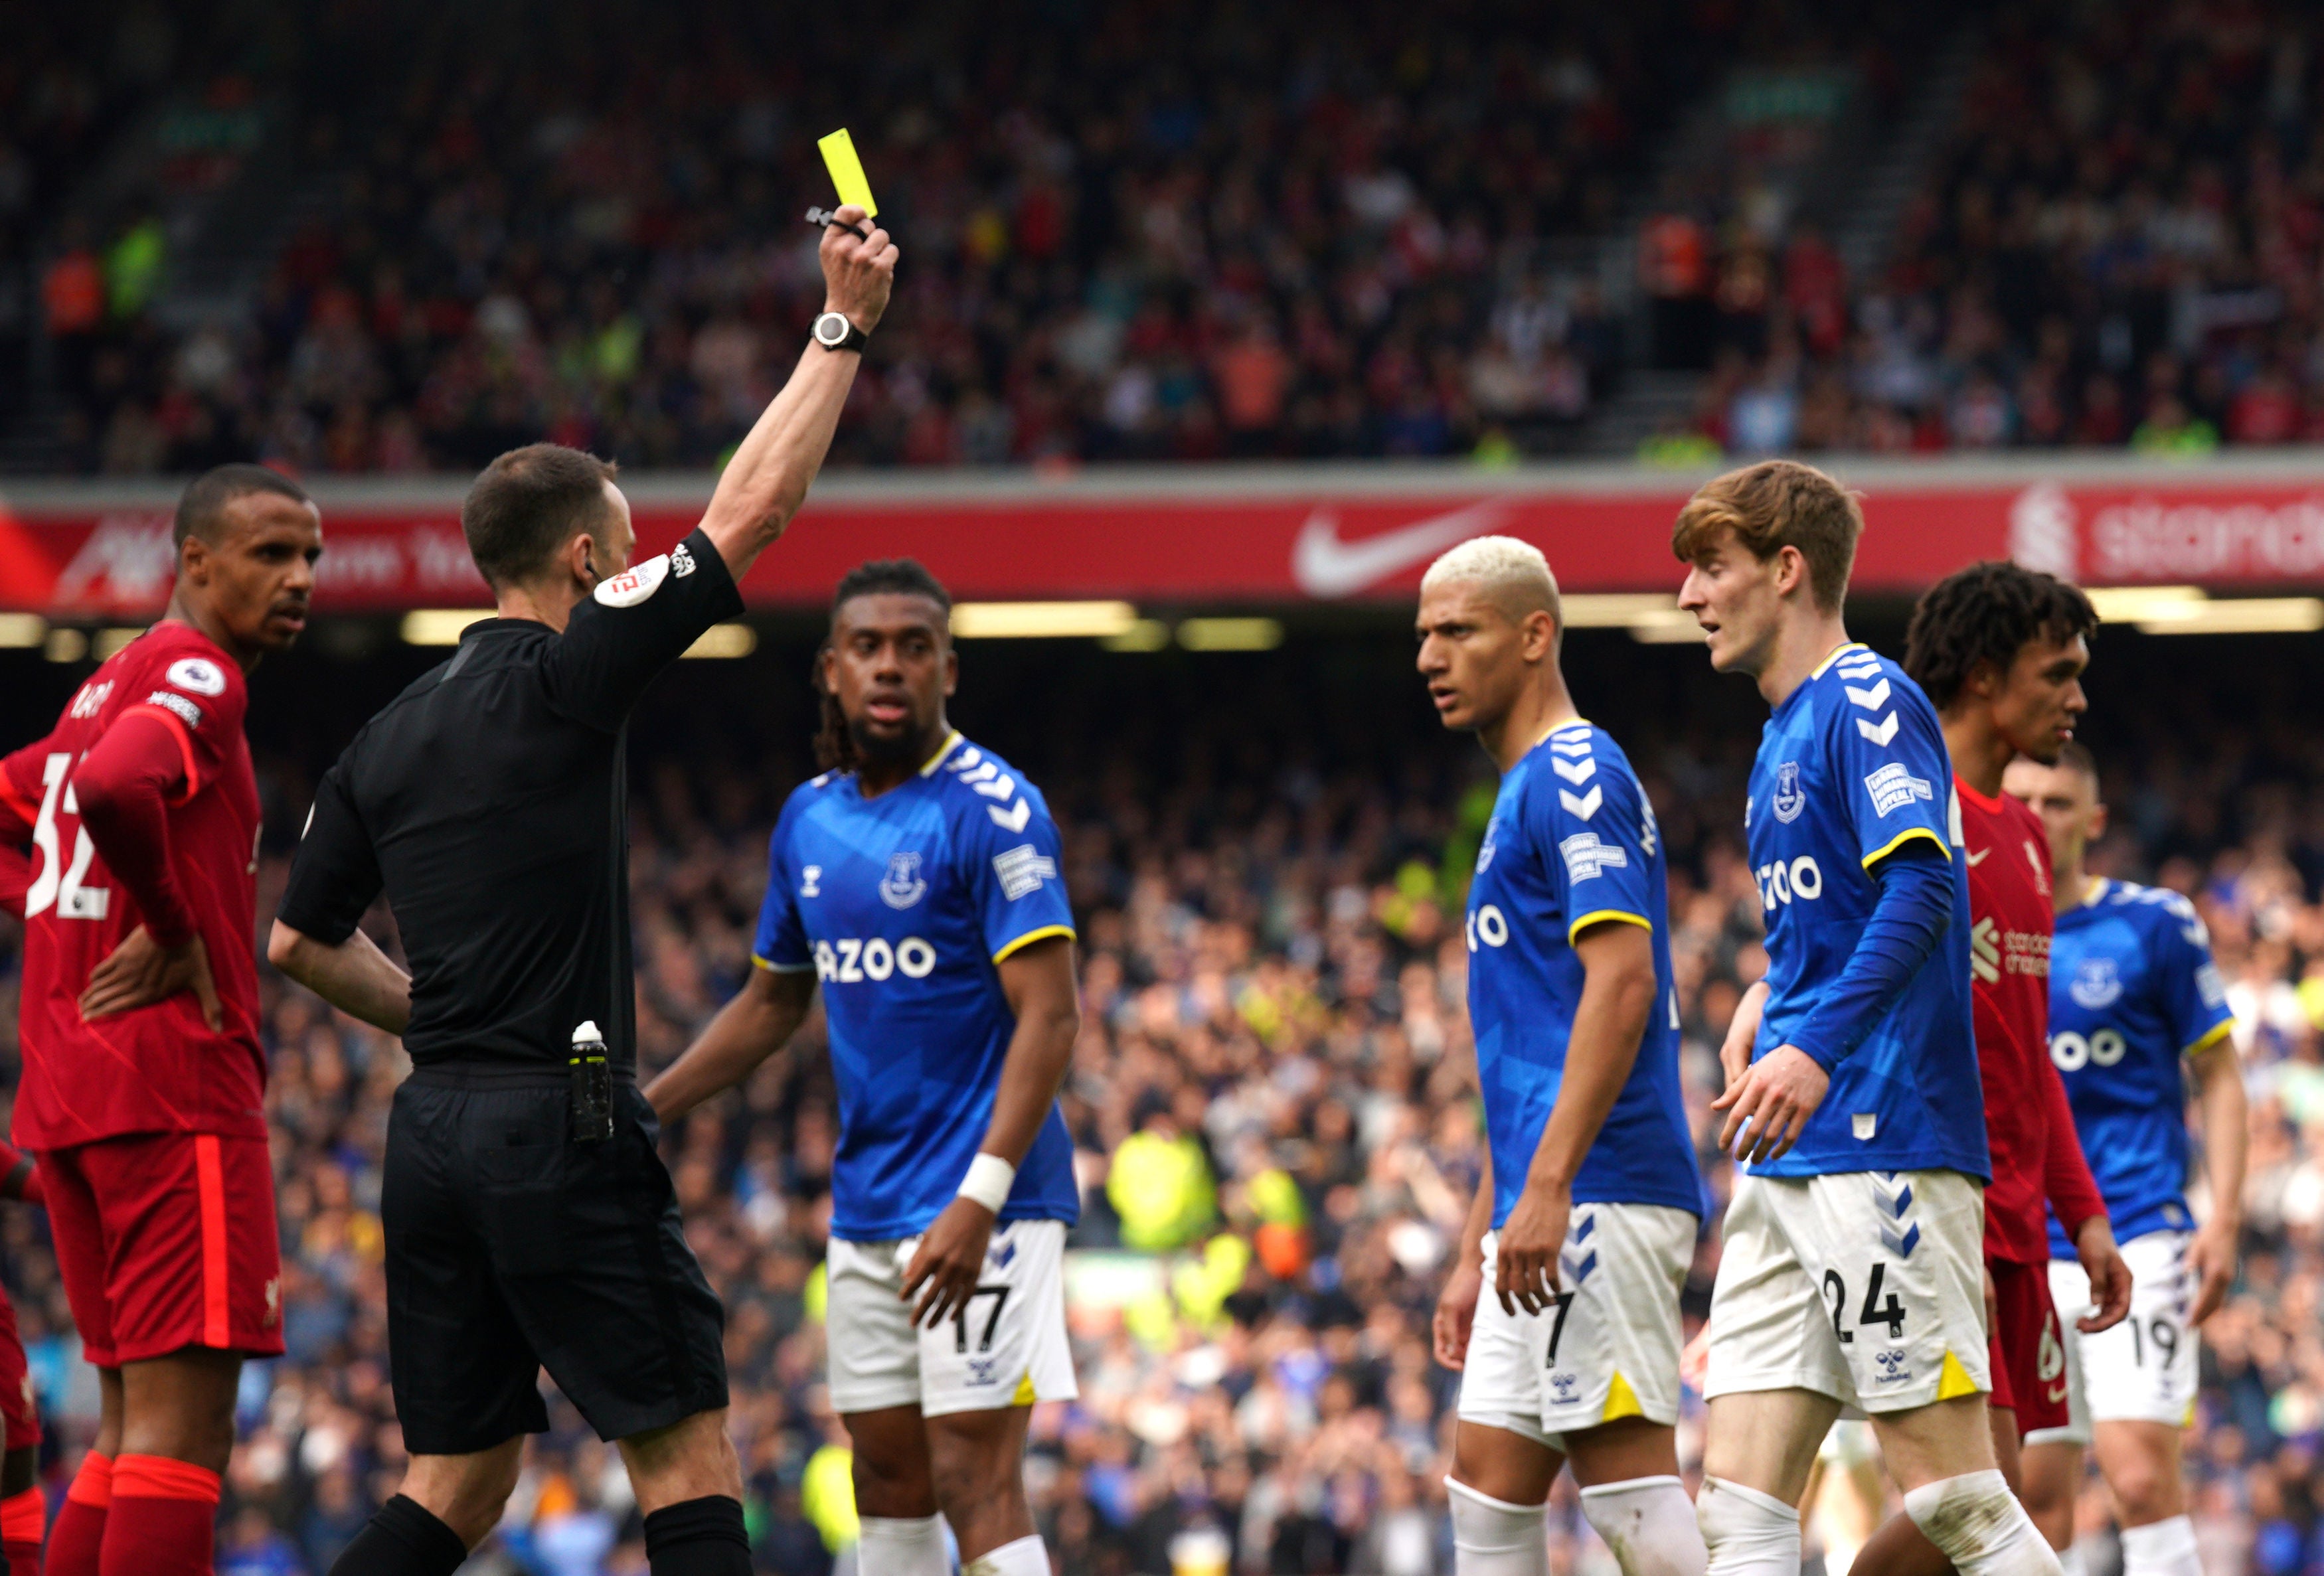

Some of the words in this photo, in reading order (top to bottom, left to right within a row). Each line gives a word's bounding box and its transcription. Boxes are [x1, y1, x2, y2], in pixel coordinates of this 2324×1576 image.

[2092, 495, 2324, 578] stand
[636, 563, 651, 586] SPOR
[1755, 855, 1822, 911] ZOO
[807, 935, 936, 983] AZOO
[2046, 1028, 2126, 1072] OO
[1546, 1291, 1575, 1368] 7
[1824, 1263, 1906, 1342] 24
[2129, 1316, 2178, 1371] 19
